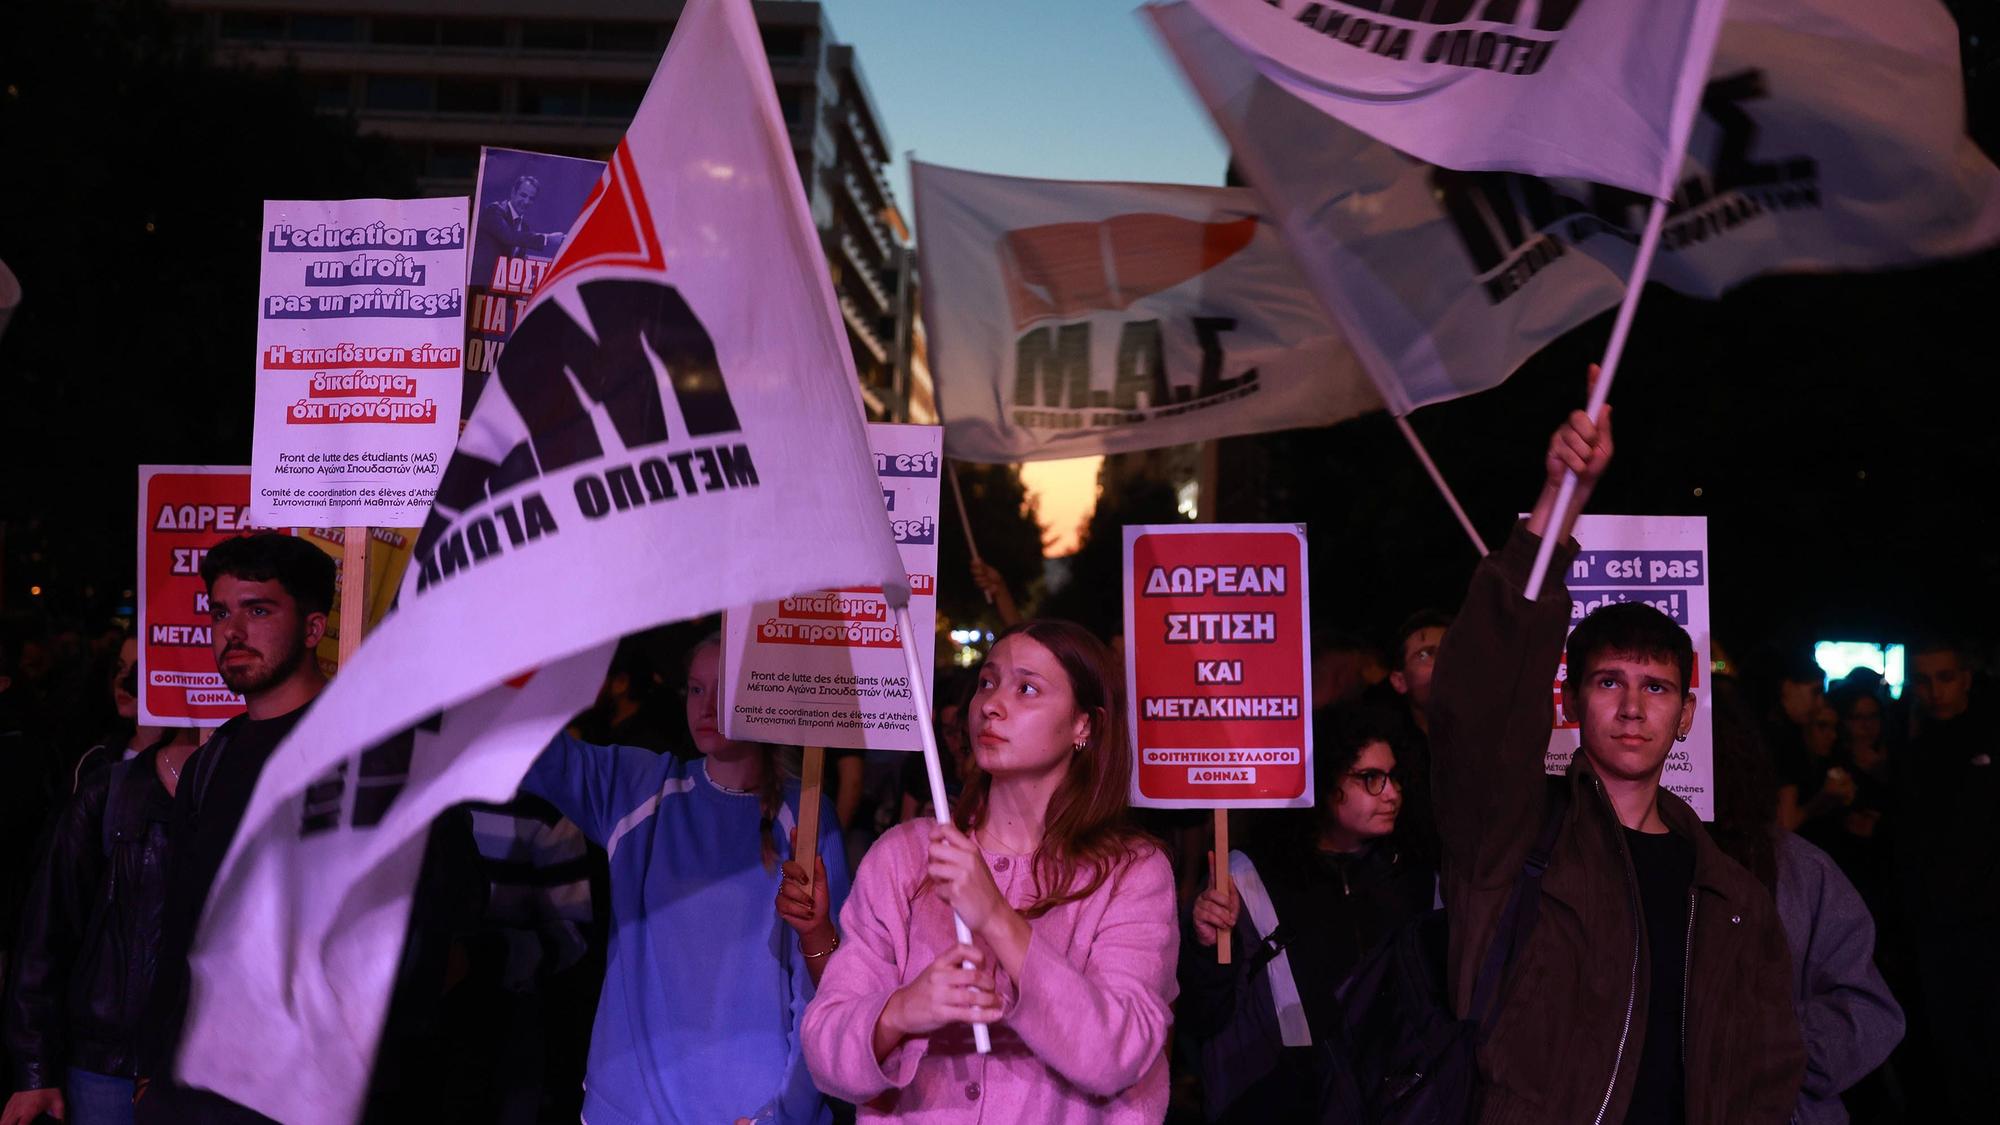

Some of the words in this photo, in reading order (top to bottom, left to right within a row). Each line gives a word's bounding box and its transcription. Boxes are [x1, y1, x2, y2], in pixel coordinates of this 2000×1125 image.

[273, 221, 418, 247] L'education
[425, 223, 461, 245] est
[313, 261, 344, 279] un
[350, 253, 422, 284] droit,
[491, 255, 549, 294] ΔΩΣΤ
[269, 295, 312, 315] pas
[319, 295, 344, 311] un
[349, 288, 459, 315] privilege!
[472, 294, 507, 332] ΓΙΑ
[270, 345, 286, 364] Η
[291, 343, 405, 365] εκπαίδευση
[411, 343, 457, 364] είναι
[314, 370, 414, 395] δικαίωμα,
[292, 399, 324, 419] όχι
[328, 398, 432, 422] προνόμιο!
[280, 453, 305, 462] Front
[307, 453, 320, 462] de
[323, 453, 341, 462] lutte
[343, 452, 359, 462] des
[362, 451, 408, 462] étudiants
[411, 452, 438, 464] (MAS)
[895, 451, 935, 472] est
[275, 464, 314, 474] Μέτωπο
[317, 464, 344, 475] Αγώνα
[347, 464, 411, 474] Σπουδαστών
[413, 463, 440, 475] (ΜΑΣ)
[261, 488, 291, 497] Comité
[294, 489, 305, 497] de
[308, 489, 356, 497] coordination
[360, 488, 375, 497] des
[379, 487, 406, 497] élèves
[409, 487, 437, 497] d'Athèn
[273, 498, 326, 507] Συντονιστική
[329, 497, 361, 508] Επιτροπή
[364, 498, 405, 507] Μαθητών
[407, 497, 434, 507] Αθήνα
[156, 505, 257, 531] ΔΩΡΕΑ
[1144, 566, 1286, 594] ΔΩΡΕΑΝ
[1605, 556, 1643, 579] est
[1650, 559, 1700, 583] pas
[762, 618, 793, 639] όχι
[1167, 613, 1276, 641] ΣΙΤΙΣΗ
[155, 674, 219, 685] ΦΟΙΤΗΤΙΚΟΙ
[751, 671, 775, 681] Front
[777, 672, 790, 682] de
[792, 673, 811, 683] lutte
[814, 674, 831, 684] des
[834, 674, 879, 686] étudiants
[881, 676, 910, 688] (MAS)
[1197, 661, 1242, 682] ΚΑΙ
[190, 693, 241, 703] ΑΘΗΝΑΣ
[747, 682, 785, 693] Μέτωπο
[787, 684, 816, 695] Αγώνα
[819, 685, 881, 698] Σπουδαστών
[883, 688, 912, 700] (ΜΑΣ)
[734, 705, 763, 715] Comité
[765, 706, 776, 715] de
[779, 708, 829, 718] coordination
[832, 710, 848, 719] des
[850, 710, 877, 720] élèves
[879, 712, 918, 722] d'Athène
[1145, 697, 1299, 718] ΜΕΤΑΚΙΝΗΣΗ
[746, 715, 796, 726] Συντονιστική
[798, 717, 834, 729] Επιτροπή
[836, 720, 876, 730] Μαθητών
[878, 722, 910, 732] Αθήνας
[1147, 752, 1226, 763] ΦΟΙΤΗΤΙΚΟΙ
[1228, 752, 1296, 763] ΣΥΛΛΟΓΟΙ
[1665, 763, 1693, 772] (ΜΑΣ)
[1193, 770, 1249, 782] ΑΘΗΝΑΣ
